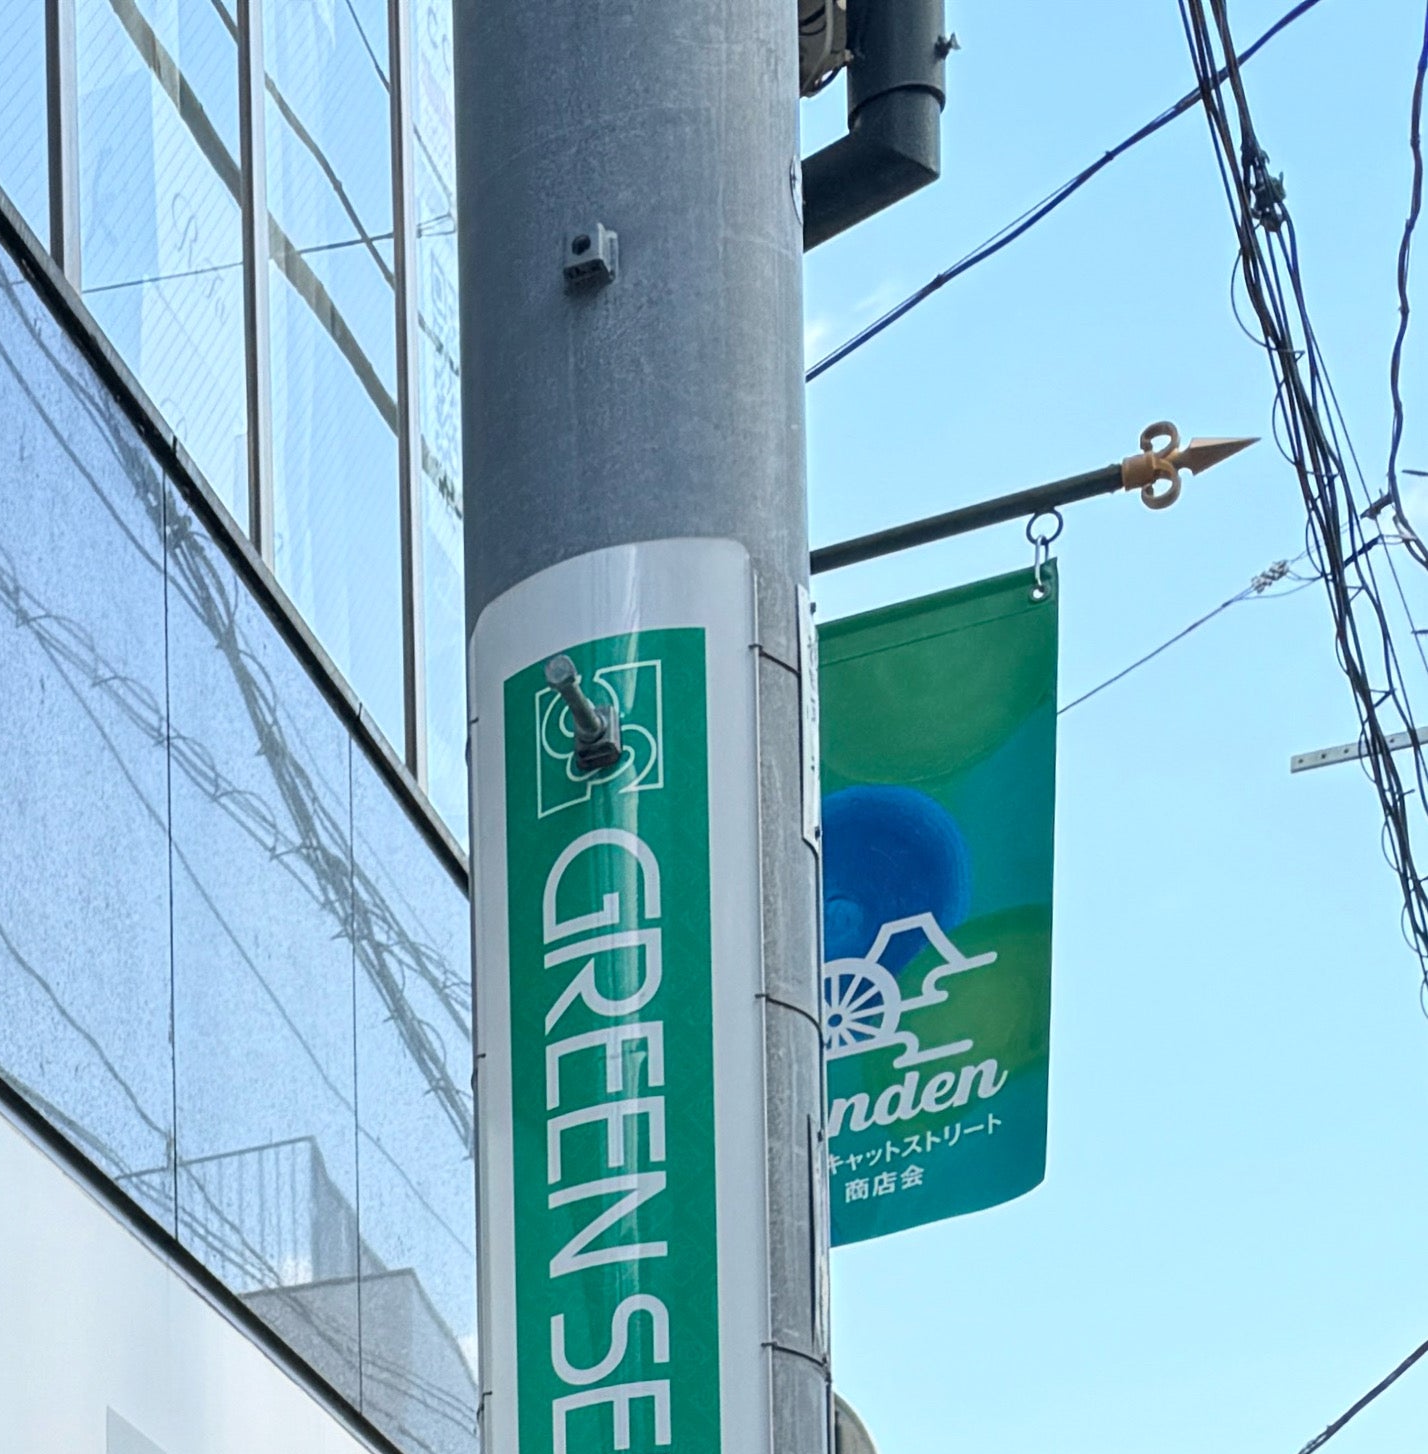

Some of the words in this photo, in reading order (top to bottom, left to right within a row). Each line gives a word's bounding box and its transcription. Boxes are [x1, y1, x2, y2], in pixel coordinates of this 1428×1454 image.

[543, 828, 668, 1279] GREEN
[827, 1058, 1008, 1138] nden
[845, 1164, 924, 1203] 商店会
